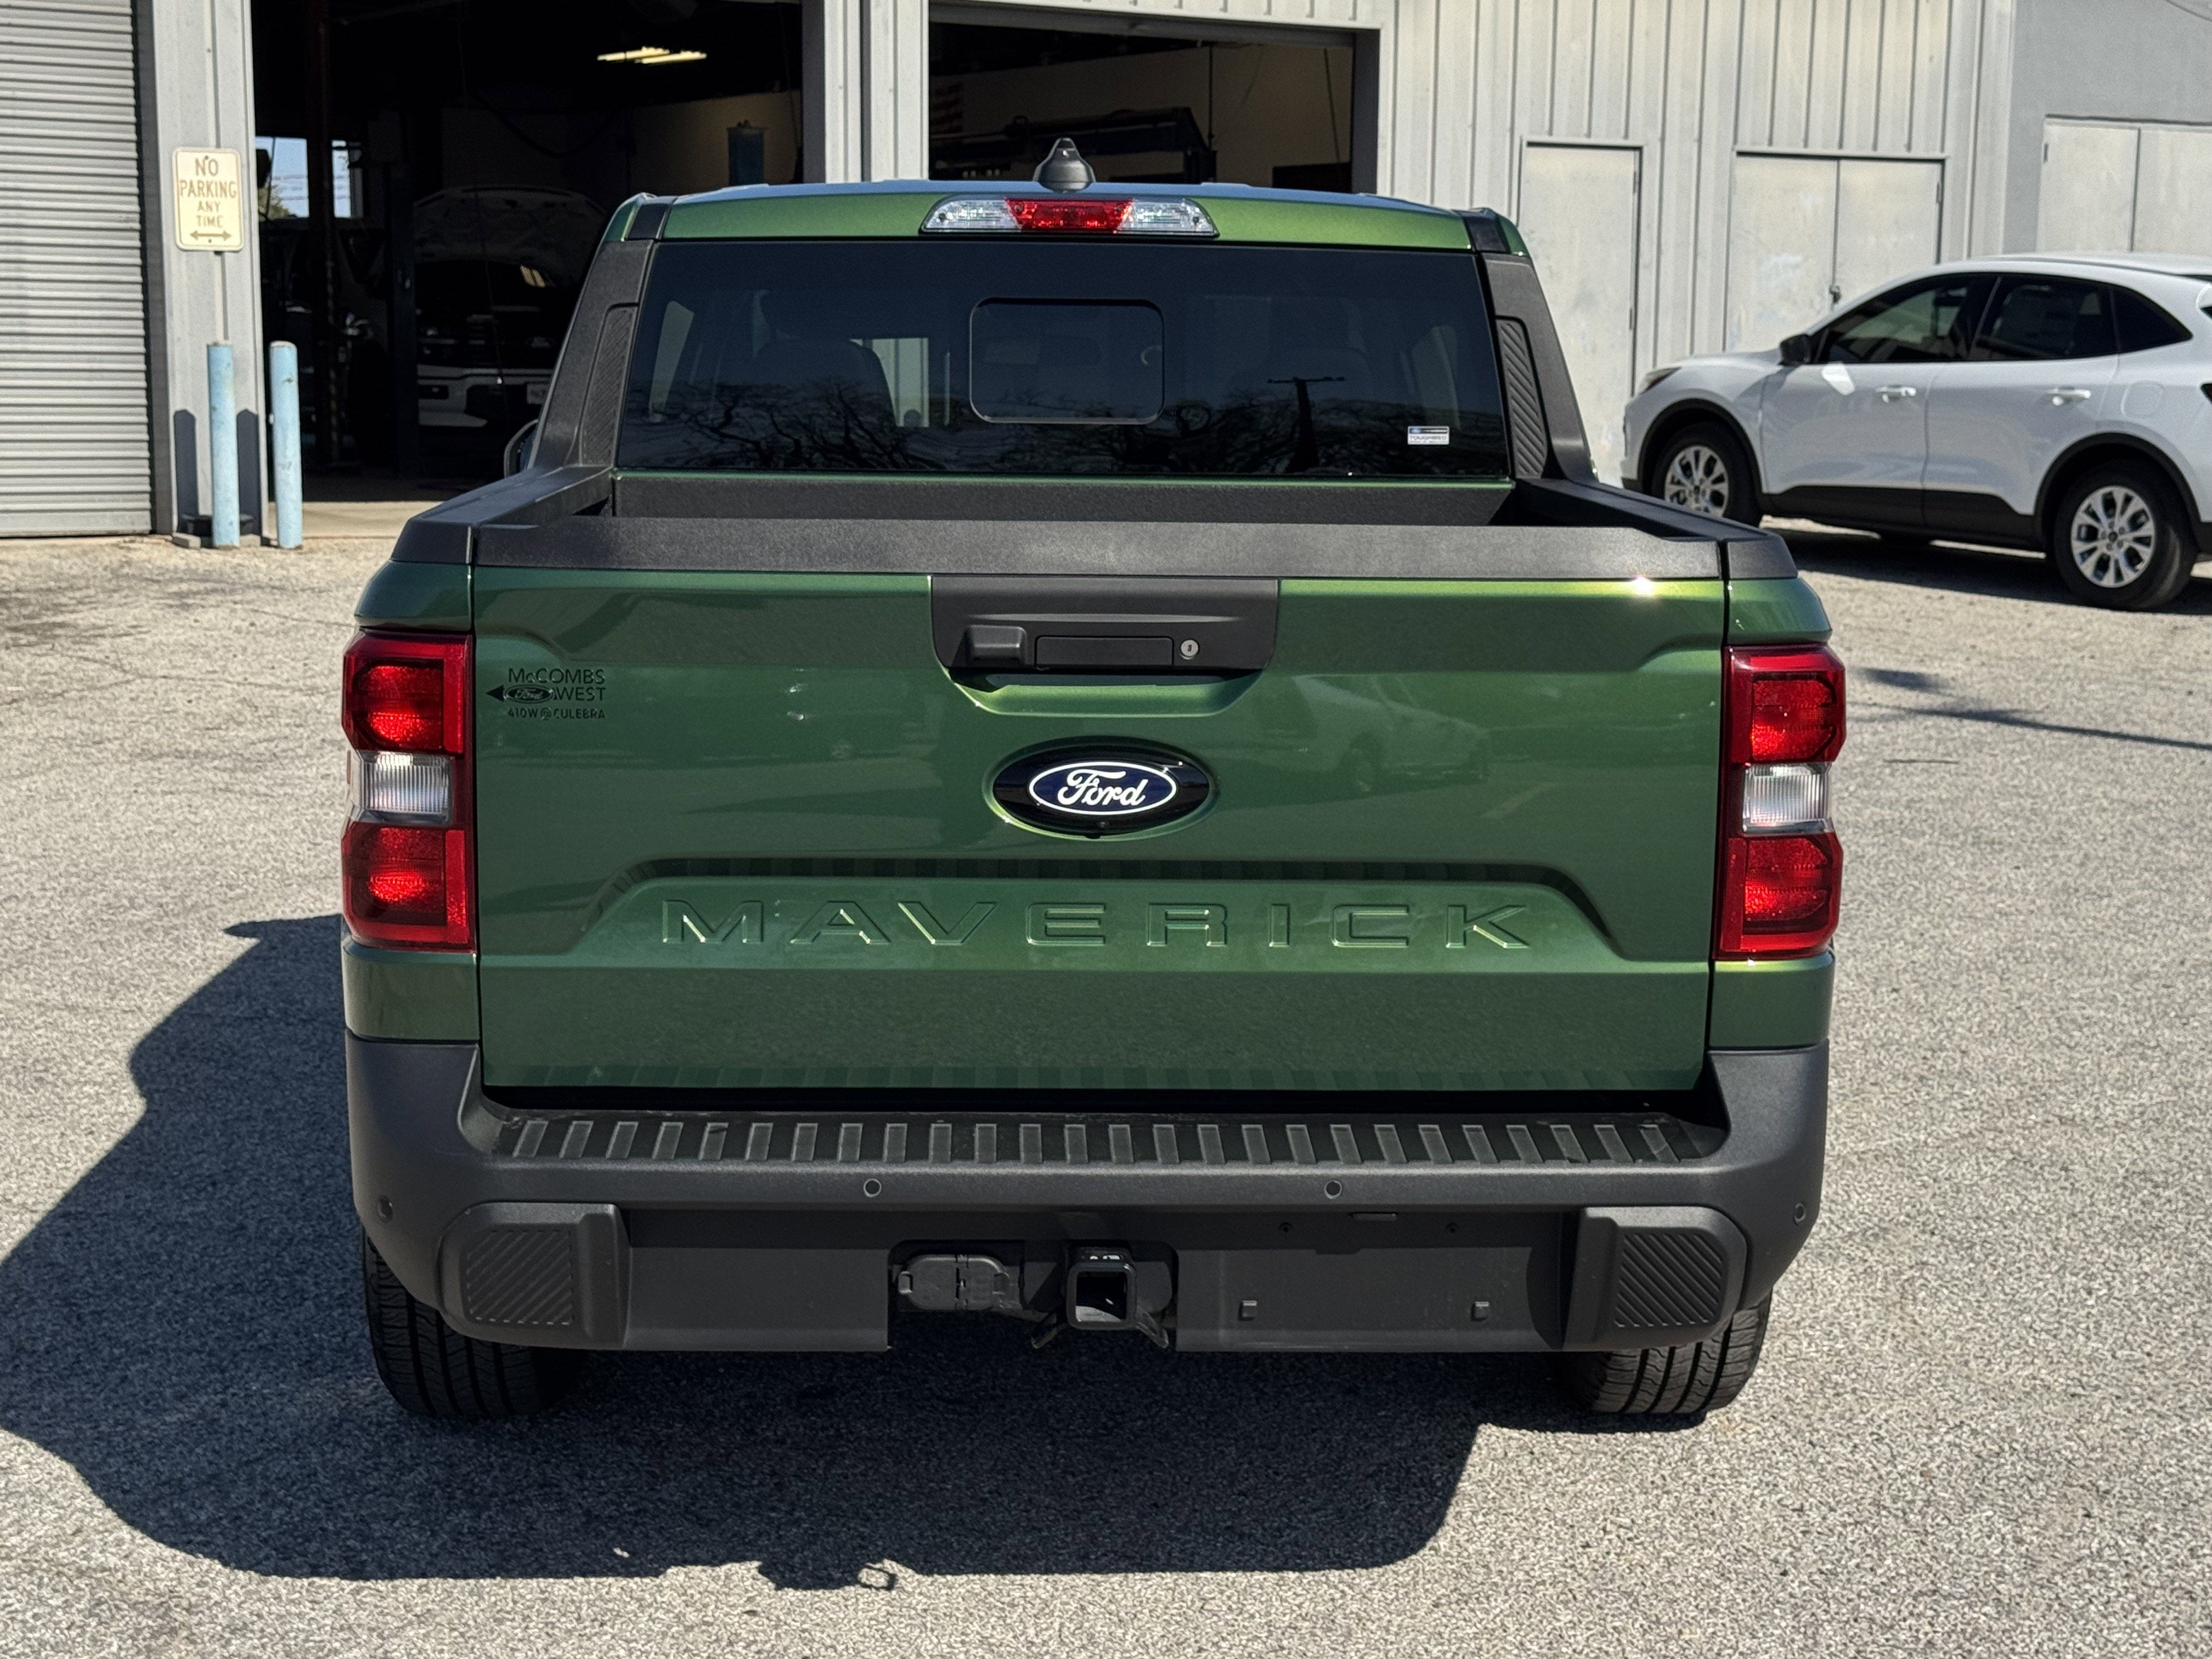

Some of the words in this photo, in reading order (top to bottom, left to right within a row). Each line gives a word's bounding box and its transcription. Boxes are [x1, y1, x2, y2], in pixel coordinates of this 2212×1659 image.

[195, 157, 219, 176] NO
[179, 179, 236, 198] PARKING
[198, 200, 221, 212] ANY
[196, 215, 224, 228] TIME
[509, 668, 605, 684] McCOMBS
[556, 687, 606, 701] WEST
[1057, 769, 1149, 806] Ford
[662, 900, 1530, 949] MAVERICK
